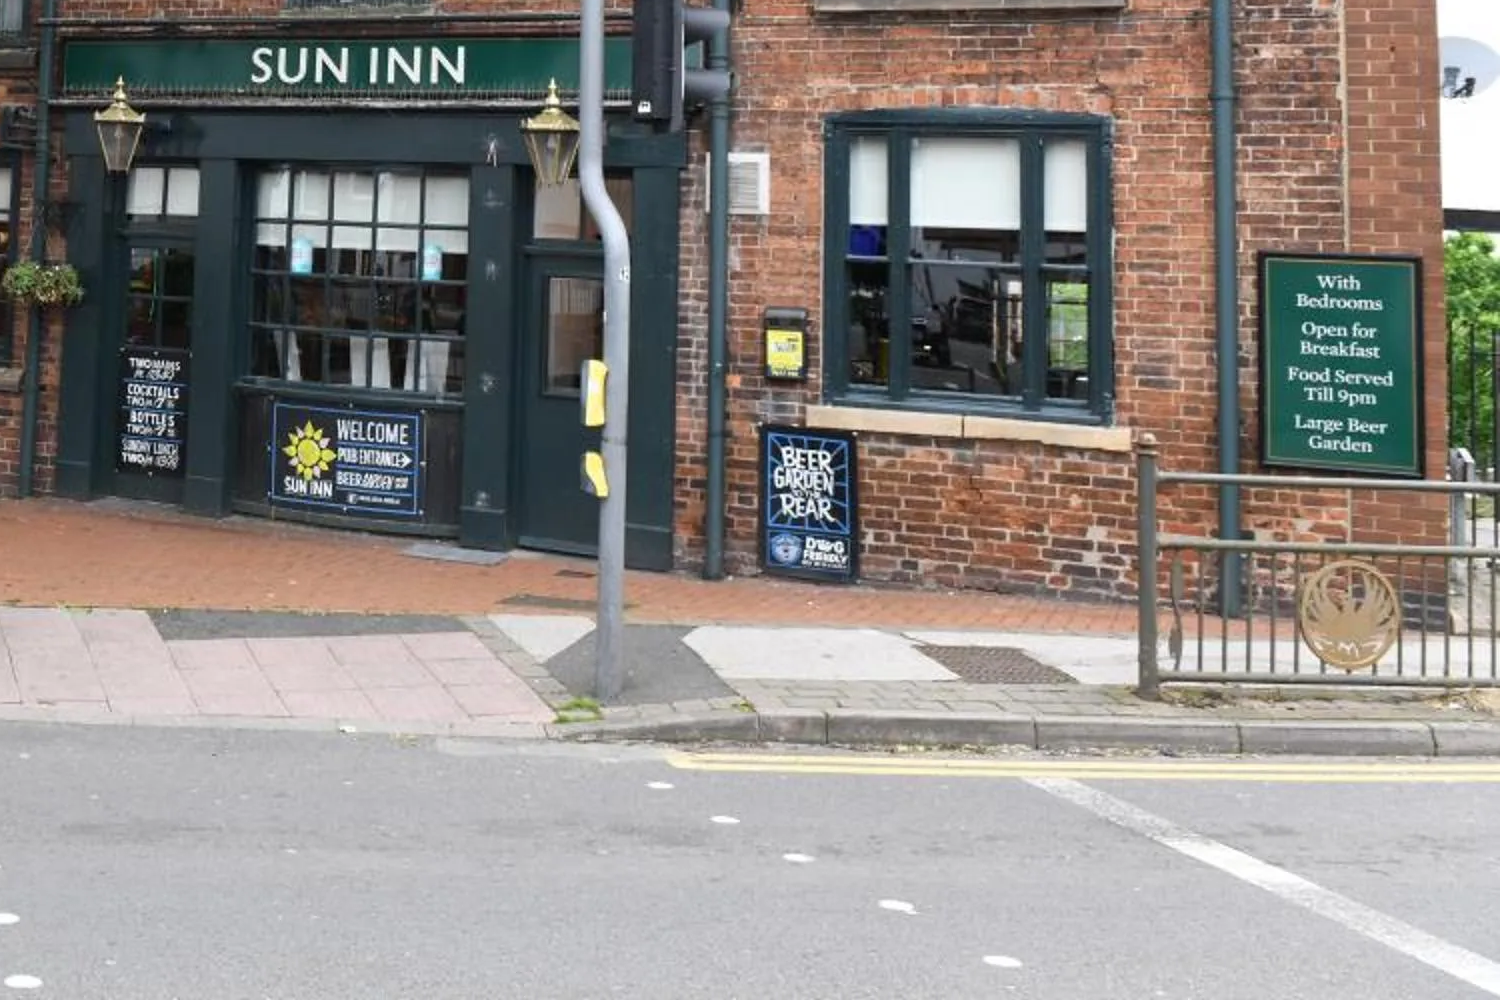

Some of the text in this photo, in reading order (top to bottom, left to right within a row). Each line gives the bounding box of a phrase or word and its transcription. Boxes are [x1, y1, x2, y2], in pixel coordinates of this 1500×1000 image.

[251, 46, 466, 84] SUN INN
[1316, 275, 1361, 291] With
[1296, 293, 1384, 311] Bedrooms
[1301, 321, 1378, 340] Open for
[1300, 341, 1381, 359] Breakfast
[1287, 366, 1394, 387] Food Served
[127, 383, 180, 399] COCKTAILS
[1303, 387, 1378, 407] Till 9pm
[130, 410, 175, 427] BOTTLES
[1294, 413, 1389, 435] Large Beer
[337, 418, 409, 445] WELCOME
[1308, 435, 1373, 453] Garden
[337, 447, 359, 463] PUB
[780, 446, 834, 475] BEER
[284, 476, 333, 497] SUN INN
[336, 471, 362, 486] BEER
[773, 466, 835, 496] GARDEN
[779, 493, 836, 522] REAR
[803, 549, 849, 565] FRIENDLY
